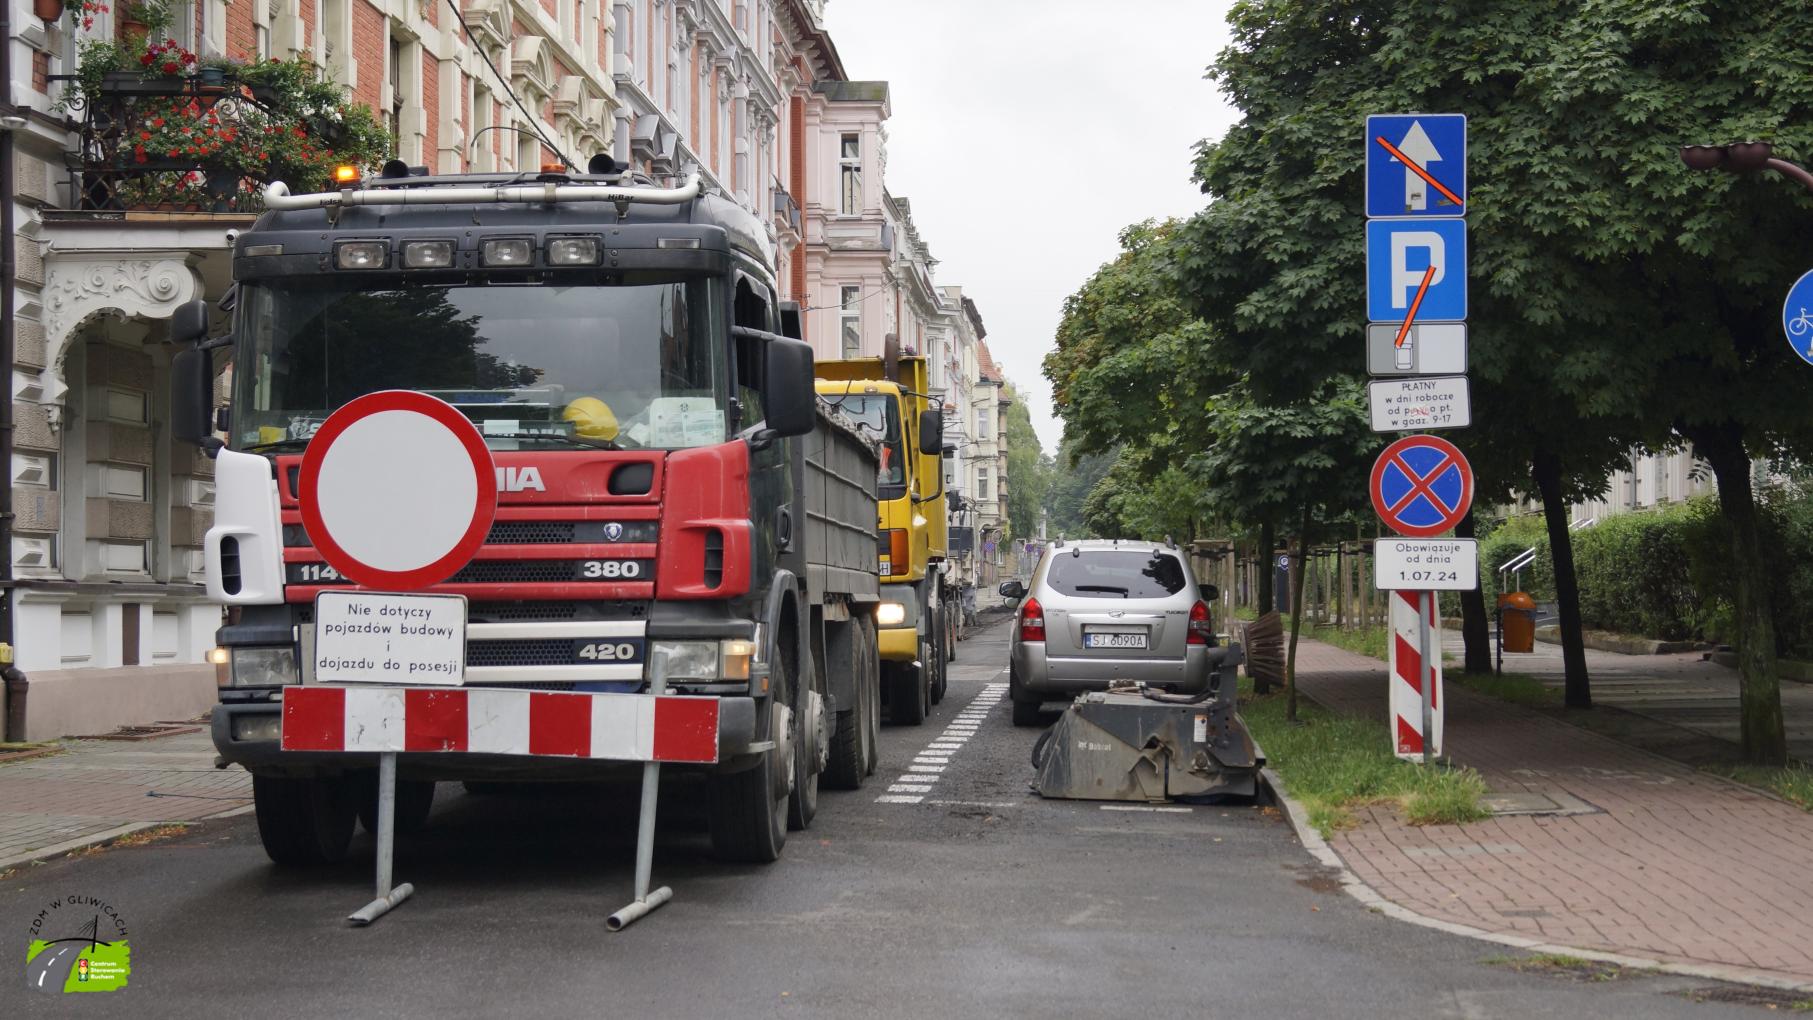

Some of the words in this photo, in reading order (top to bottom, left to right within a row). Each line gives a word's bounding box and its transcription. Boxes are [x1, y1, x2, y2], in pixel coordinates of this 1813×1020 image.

[1391, 231, 1446, 309] P
[1401, 381, 1437, 391] PŁATNY
[1396, 394, 1412, 403] dni
[1415, 393, 1454, 402] robocze
[1387, 407, 1400, 415] od
[1440, 404, 1453, 414] pt.
[1402, 418, 1429, 428] godz.
[1432, 415, 1452, 424] 9-17
[1395, 543, 1461, 554] Obowiązuje
[1406, 555, 1420, 563] od
[1426, 555, 1451, 564] dnia
[301, 564, 349, 581] 114
[583, 561, 640, 578] 380
[1399, 571, 1457, 581] 1.07.24
[348, 603, 372, 616] Nie
[379, 604, 432, 620] dotyczy
[325, 621, 392, 636] pojazdów
[400, 623, 454, 639] budowy
[386, 640, 390, 652] i
[1093, 634, 1107, 647] SJ
[1110, 635, 1144, 647] 6090A
[579, 643, 635, 660] 420
[319, 657, 375, 671] dojazdu
[383, 658, 401, 670] do
[409, 660, 457, 674] posesji
